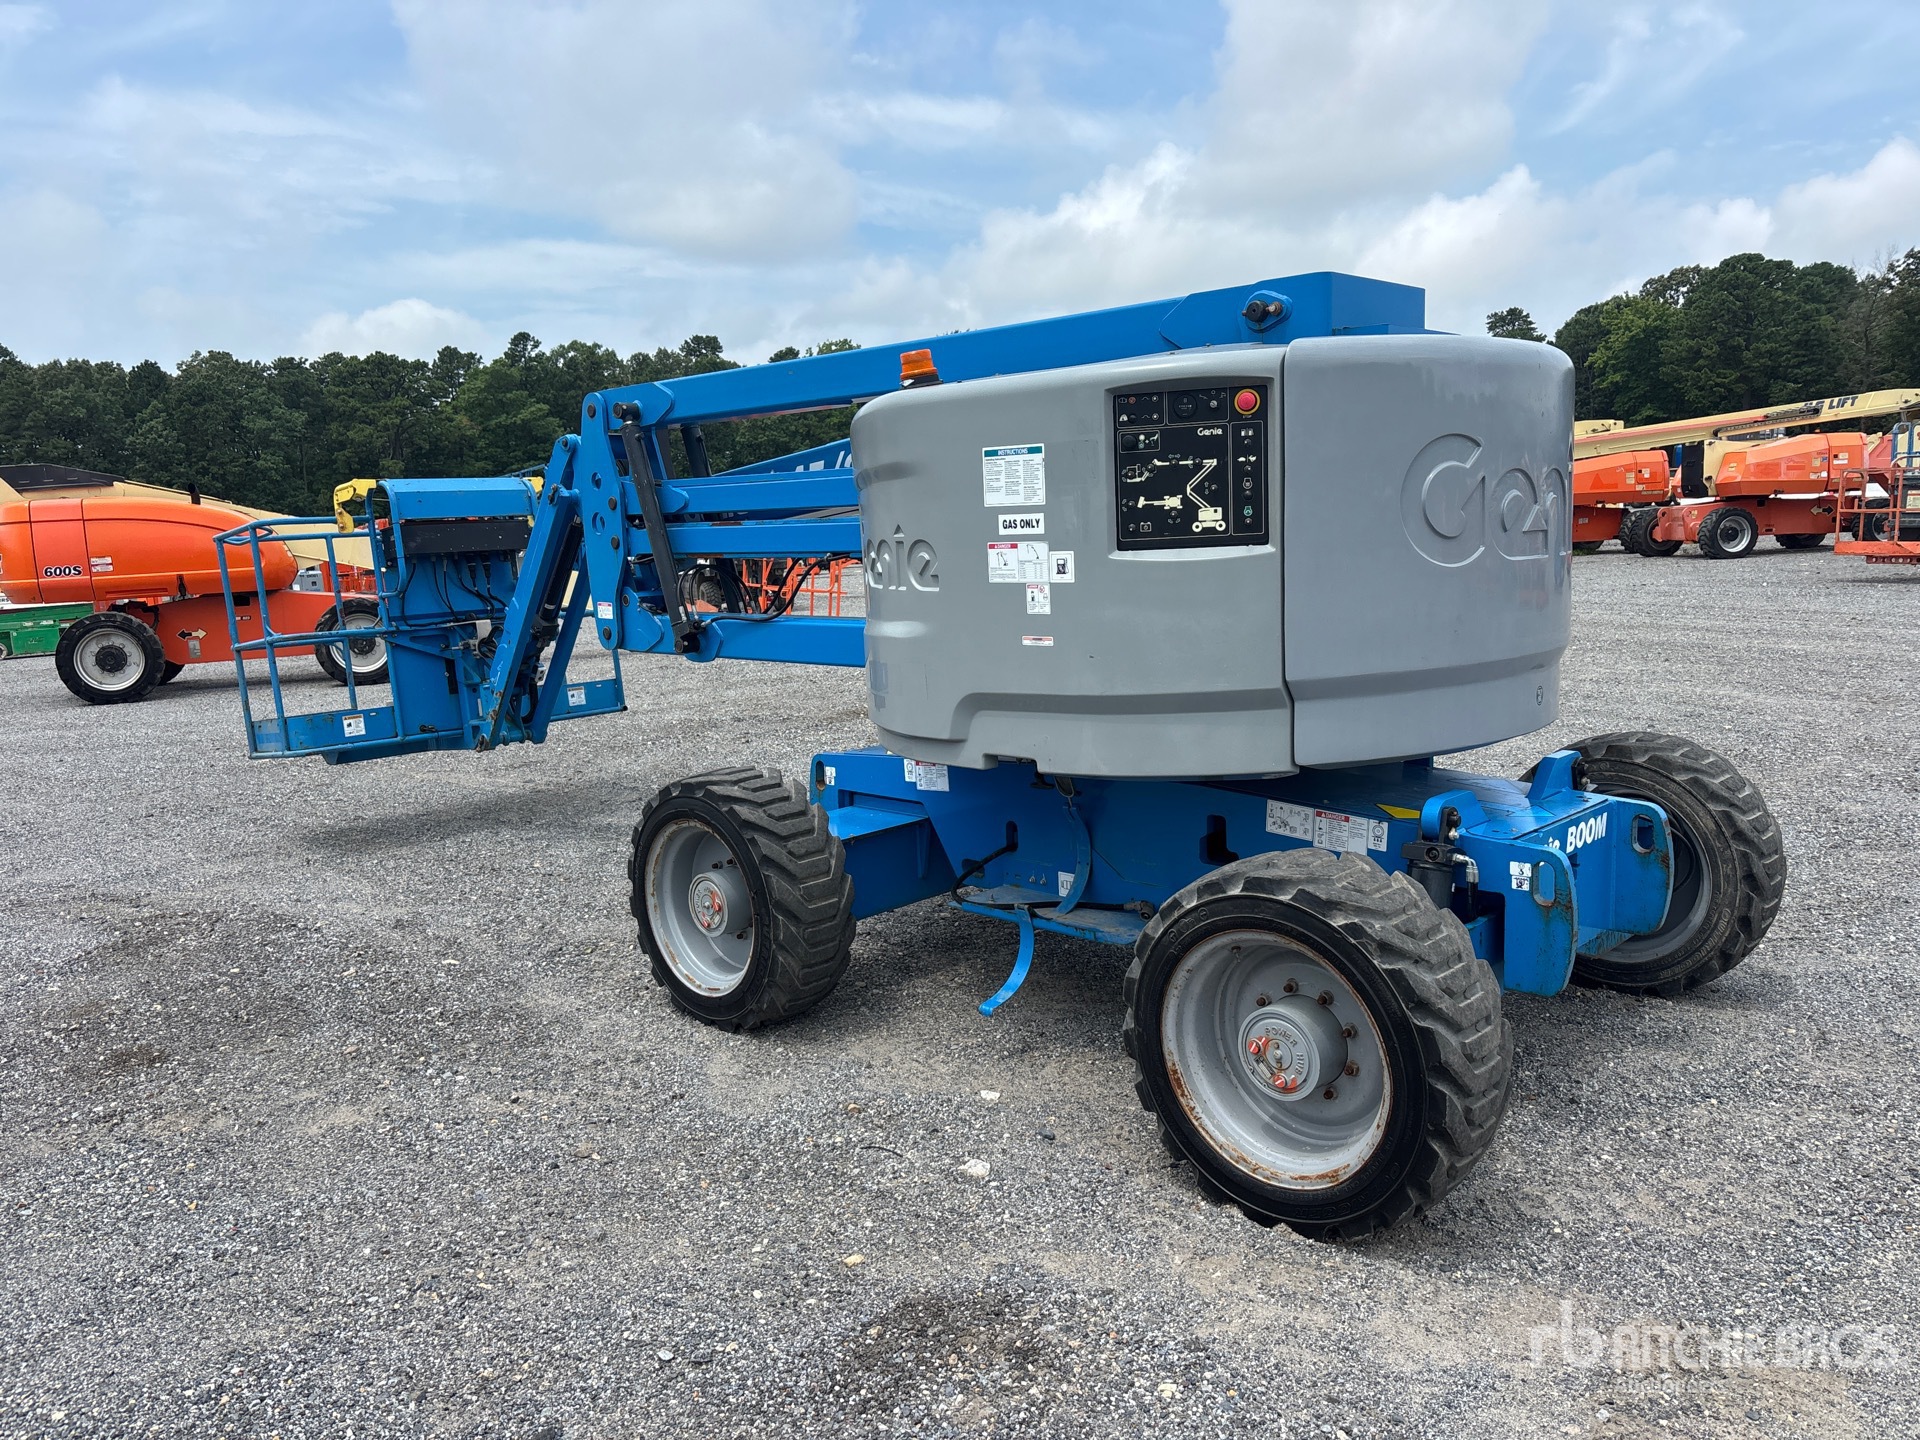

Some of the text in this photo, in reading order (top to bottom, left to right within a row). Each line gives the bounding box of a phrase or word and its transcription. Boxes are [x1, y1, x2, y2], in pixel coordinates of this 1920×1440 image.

[1828, 396, 1859, 410] LIFT
[1197, 427, 1223, 436] Genie
[997, 447, 1029, 456] INSTRUCTIONS
[1400, 433, 1571, 567] Gen
[1002, 518, 1040, 529] GAS ONLY
[864, 524, 940, 592] enie
[43, 565, 83, 577] 600S
[1326, 812, 1346, 821] DANGER
[1566, 812, 1607, 853] BOOM
